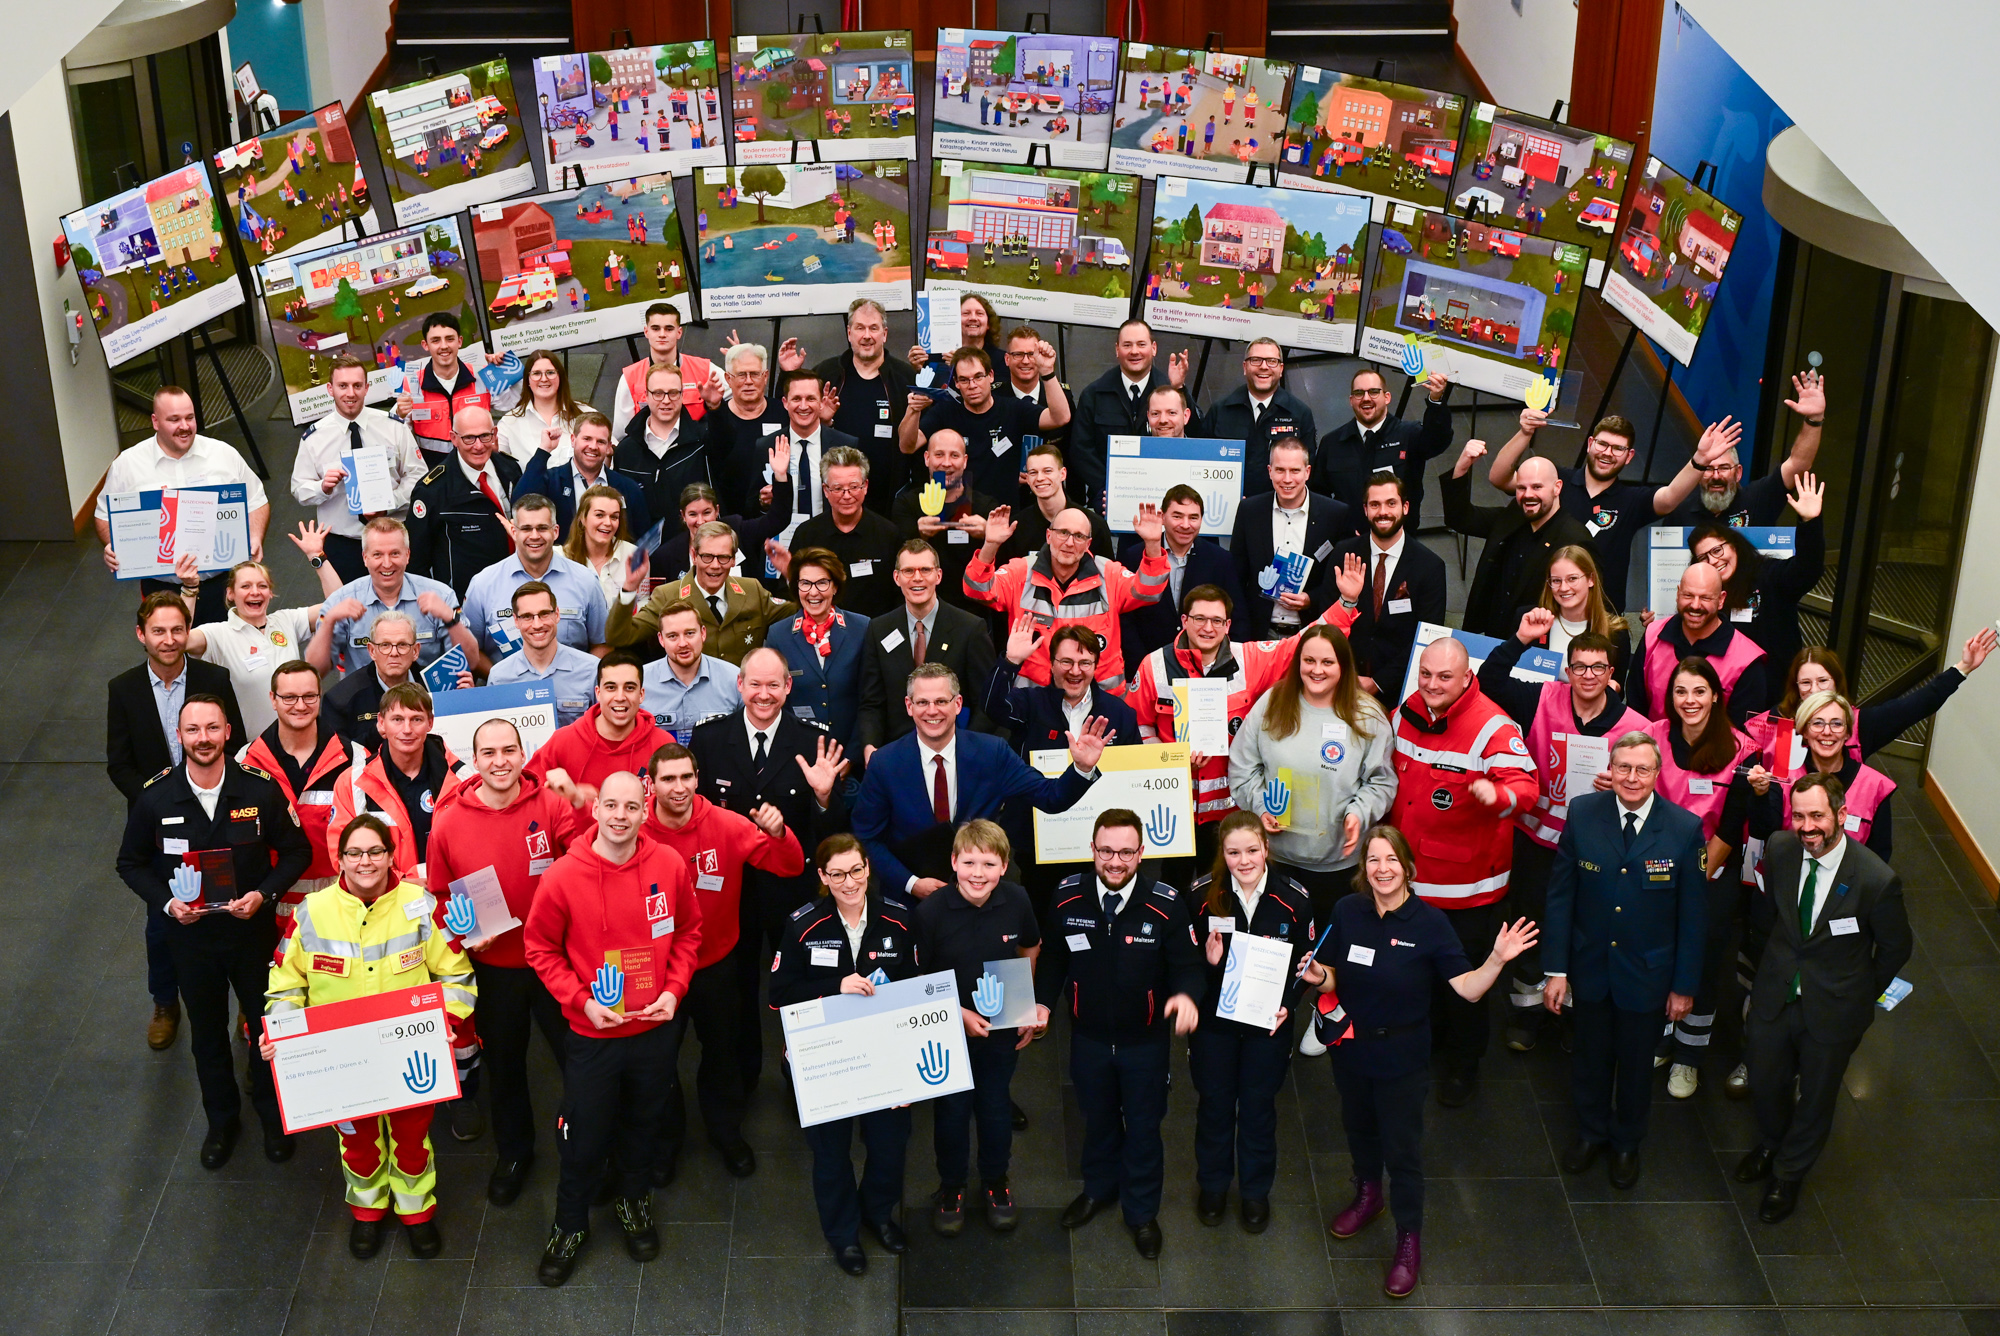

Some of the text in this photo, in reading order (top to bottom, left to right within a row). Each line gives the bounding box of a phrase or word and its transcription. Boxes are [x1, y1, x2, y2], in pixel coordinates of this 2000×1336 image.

[940, 144, 990, 152] Katastrophenschutz
[596, 161, 630, 170] Einsatzdienst
[1116, 153, 1151, 164] Wasserrettung
[1169, 161, 1218, 173] Katastrophenschutz
[995, 299, 1020, 307] Münster
[1015, 294, 1049, 302] Feuerwehr-
[1164, 316, 1188, 324] Bremen
[1222, 315, 1251, 324] Barrieren
[500, 332, 518, 341] Feuer
[525, 328, 543, 336] Flosse
[550, 324, 567, 332] Wenn
[568, 317, 597, 328] Ehrenamt
[120, 336, 143, 350] Hamburg
[501, 339, 523, 348] Wellen
[523, 334, 545, 344] schlägt
[559, 328, 579, 337] Kissing
[1380, 344, 1404, 358] Hambur
[298, 393, 329, 405] Reflexives
[1202, 469, 1234, 480] 3.000
[510, 714, 546, 729] 2.000
[1570, 743, 1604, 751] AUSZEICHNUNG
[1321, 763, 1338, 772] Marina
[1143, 777, 1180, 791] 4.000
[238, 807, 259, 818] ASB
[1250, 946, 1286, 958] AUSZEICHNUNG
[624, 957, 652, 965] Helfende
[624, 963, 641, 971] Hand
[636, 982, 653, 990] 2025
[909, 1009, 948, 1029] 9.000
[394, 1020, 435, 1040] 9.000
[799, 1042, 831, 1053] neuntausend
[281, 1050, 315, 1062] neuntausend
[802, 1063, 826, 1072] Malteser
[827, 1056, 856, 1066] Hilfsdienst
[285, 1073, 297, 1081] ASB
[306, 1065, 335, 1076] Rhein-Erft
[339, 1061, 357, 1069] Düren
[804, 1062, 872, 1082] Malteser Jugend Bremen
